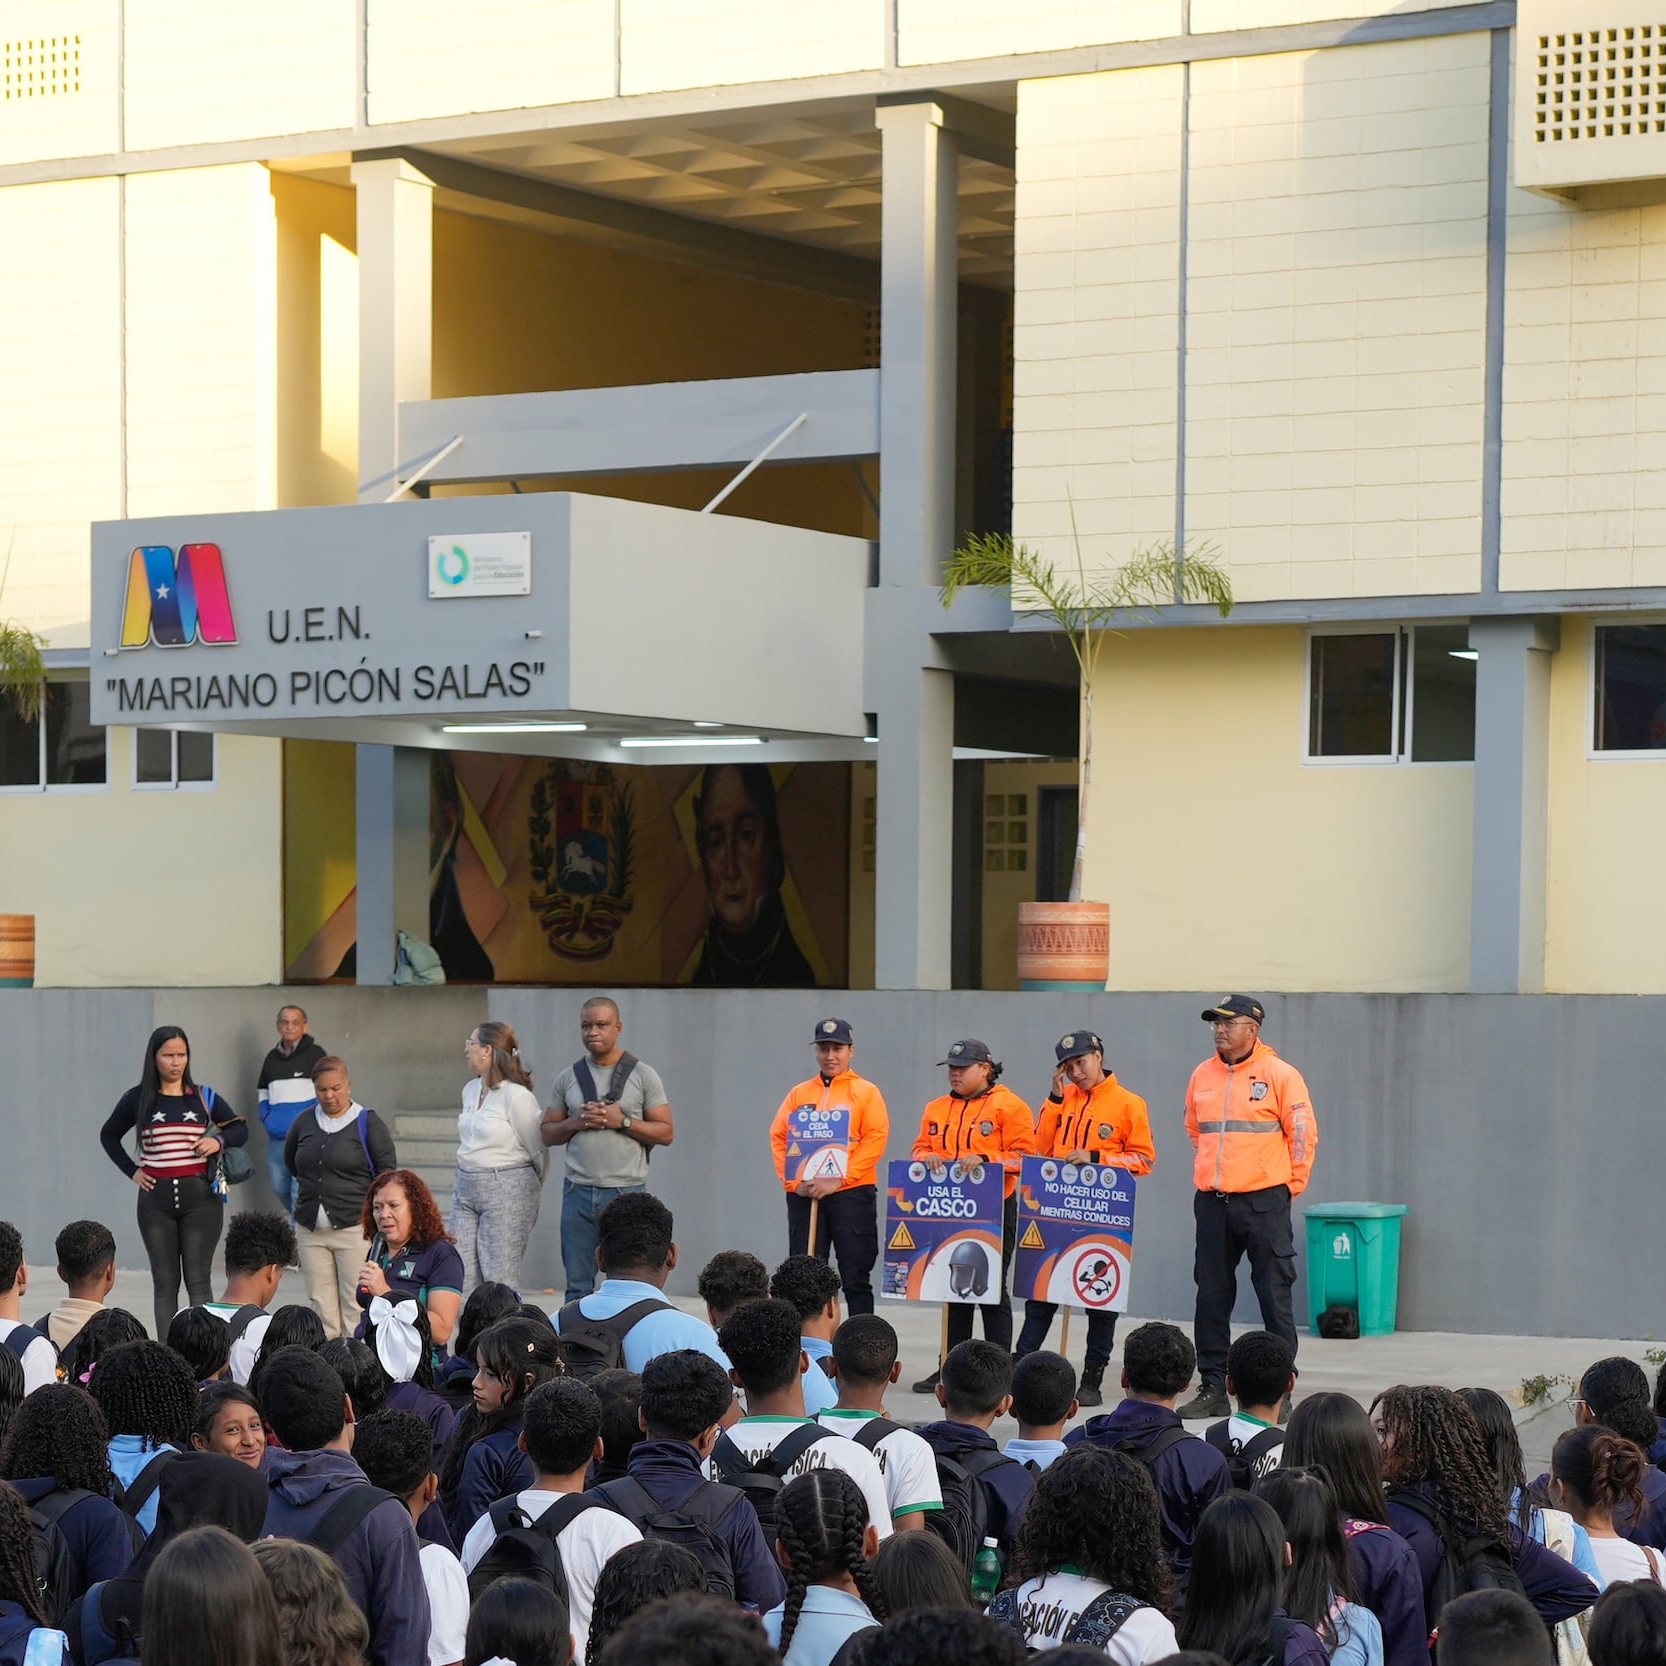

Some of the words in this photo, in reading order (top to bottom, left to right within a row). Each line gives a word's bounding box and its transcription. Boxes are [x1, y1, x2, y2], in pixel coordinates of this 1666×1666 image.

[269, 605, 370, 643] U.E.N.
[107, 673, 277, 711] "MARIANO
[291, 656, 400, 705] PICÓN
[414, 661, 545, 700] SALAS"
[802, 1130, 813, 1138] EL
[814, 1129, 834, 1138] PASO
[808, 1122, 829, 1131] CEDA
[927, 1186, 950, 1198] USA
[951, 1187, 964, 1198] EL
[1045, 1182, 1059, 1194] NO
[1060, 1184, 1090, 1197] HACER
[1091, 1188, 1111, 1200] USO
[1112, 1190, 1129, 1203] DEL
[916, 1197, 977, 1218] CASCO
[1064, 1196, 1109, 1213] CELULAR
[1040, 1205, 1083, 1221] MIENTRAS
[1083, 1211, 1131, 1227] CONDUCES
